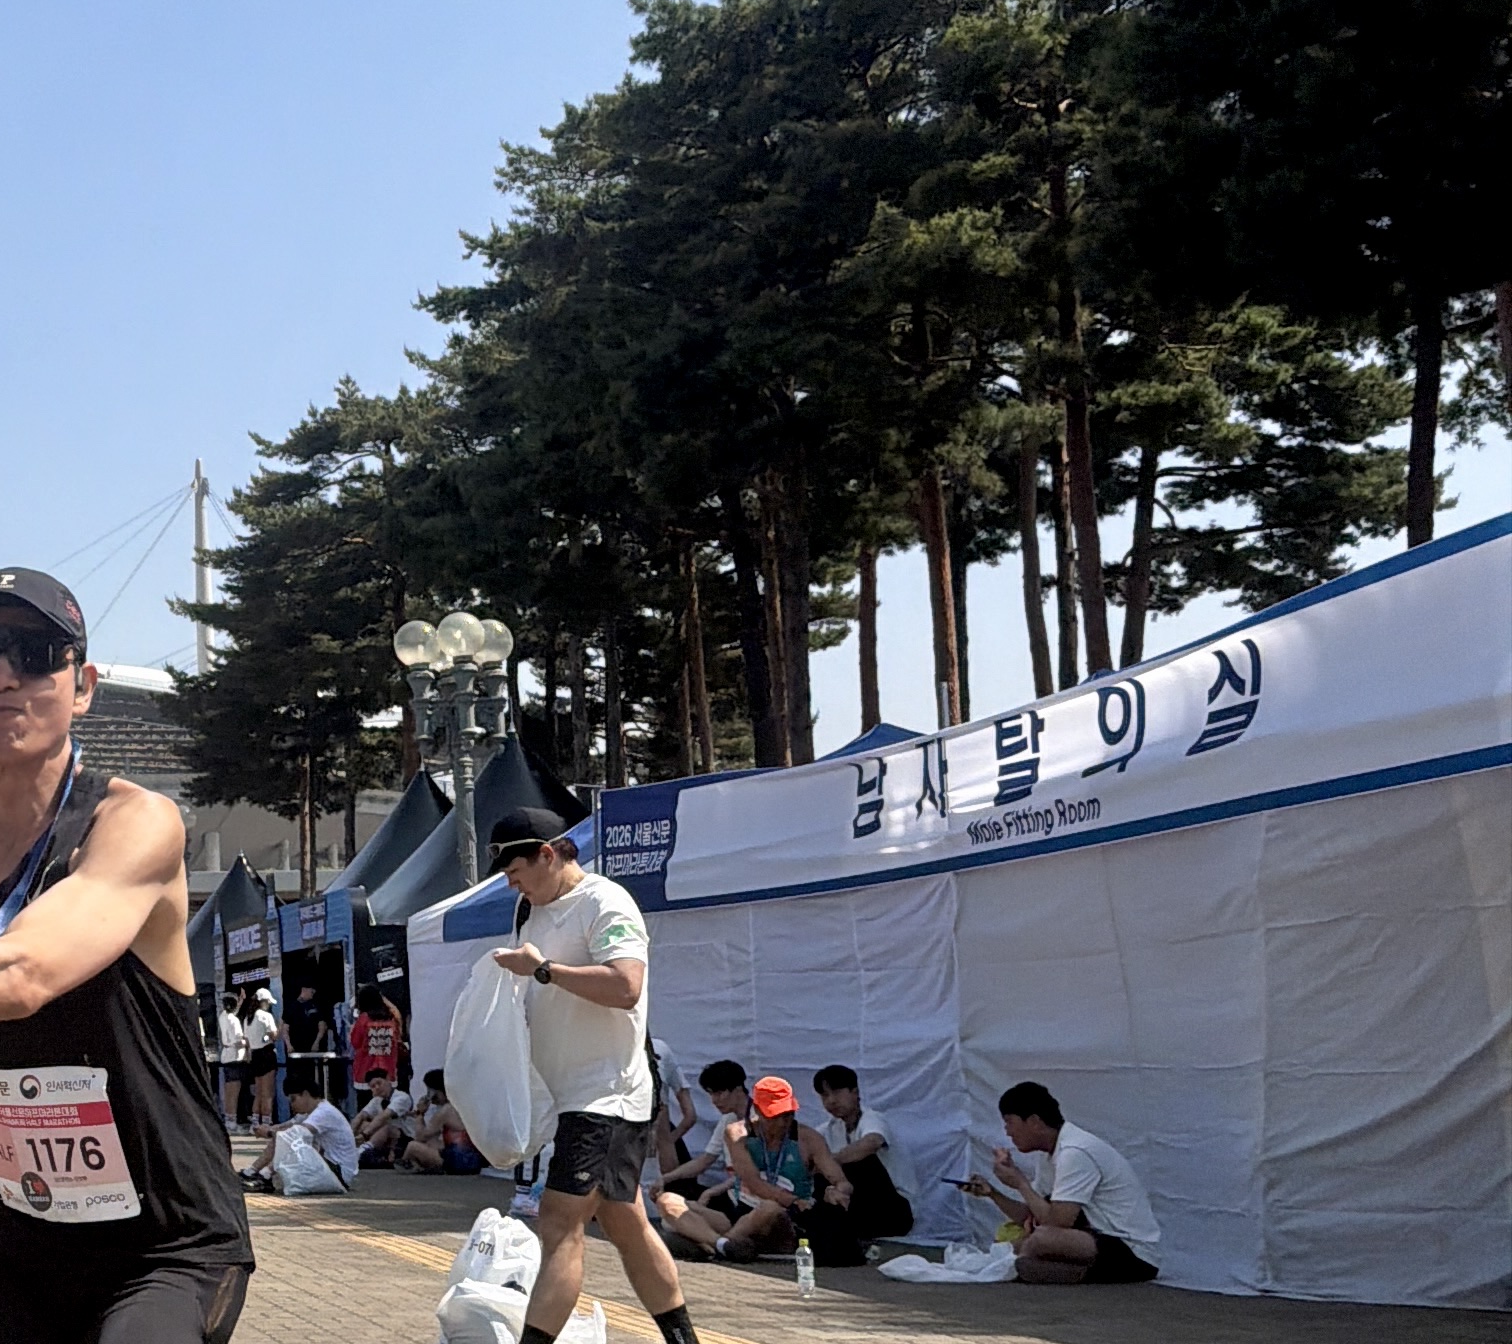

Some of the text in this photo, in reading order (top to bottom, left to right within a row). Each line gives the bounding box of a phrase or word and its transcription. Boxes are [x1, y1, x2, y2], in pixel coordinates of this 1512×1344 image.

[605, 819, 671, 848] 2026 서울신문
[1003, 805, 1054, 838] Fitting
[1054, 797, 1101, 827] Room
[25, 1136, 106, 1173] 1176
